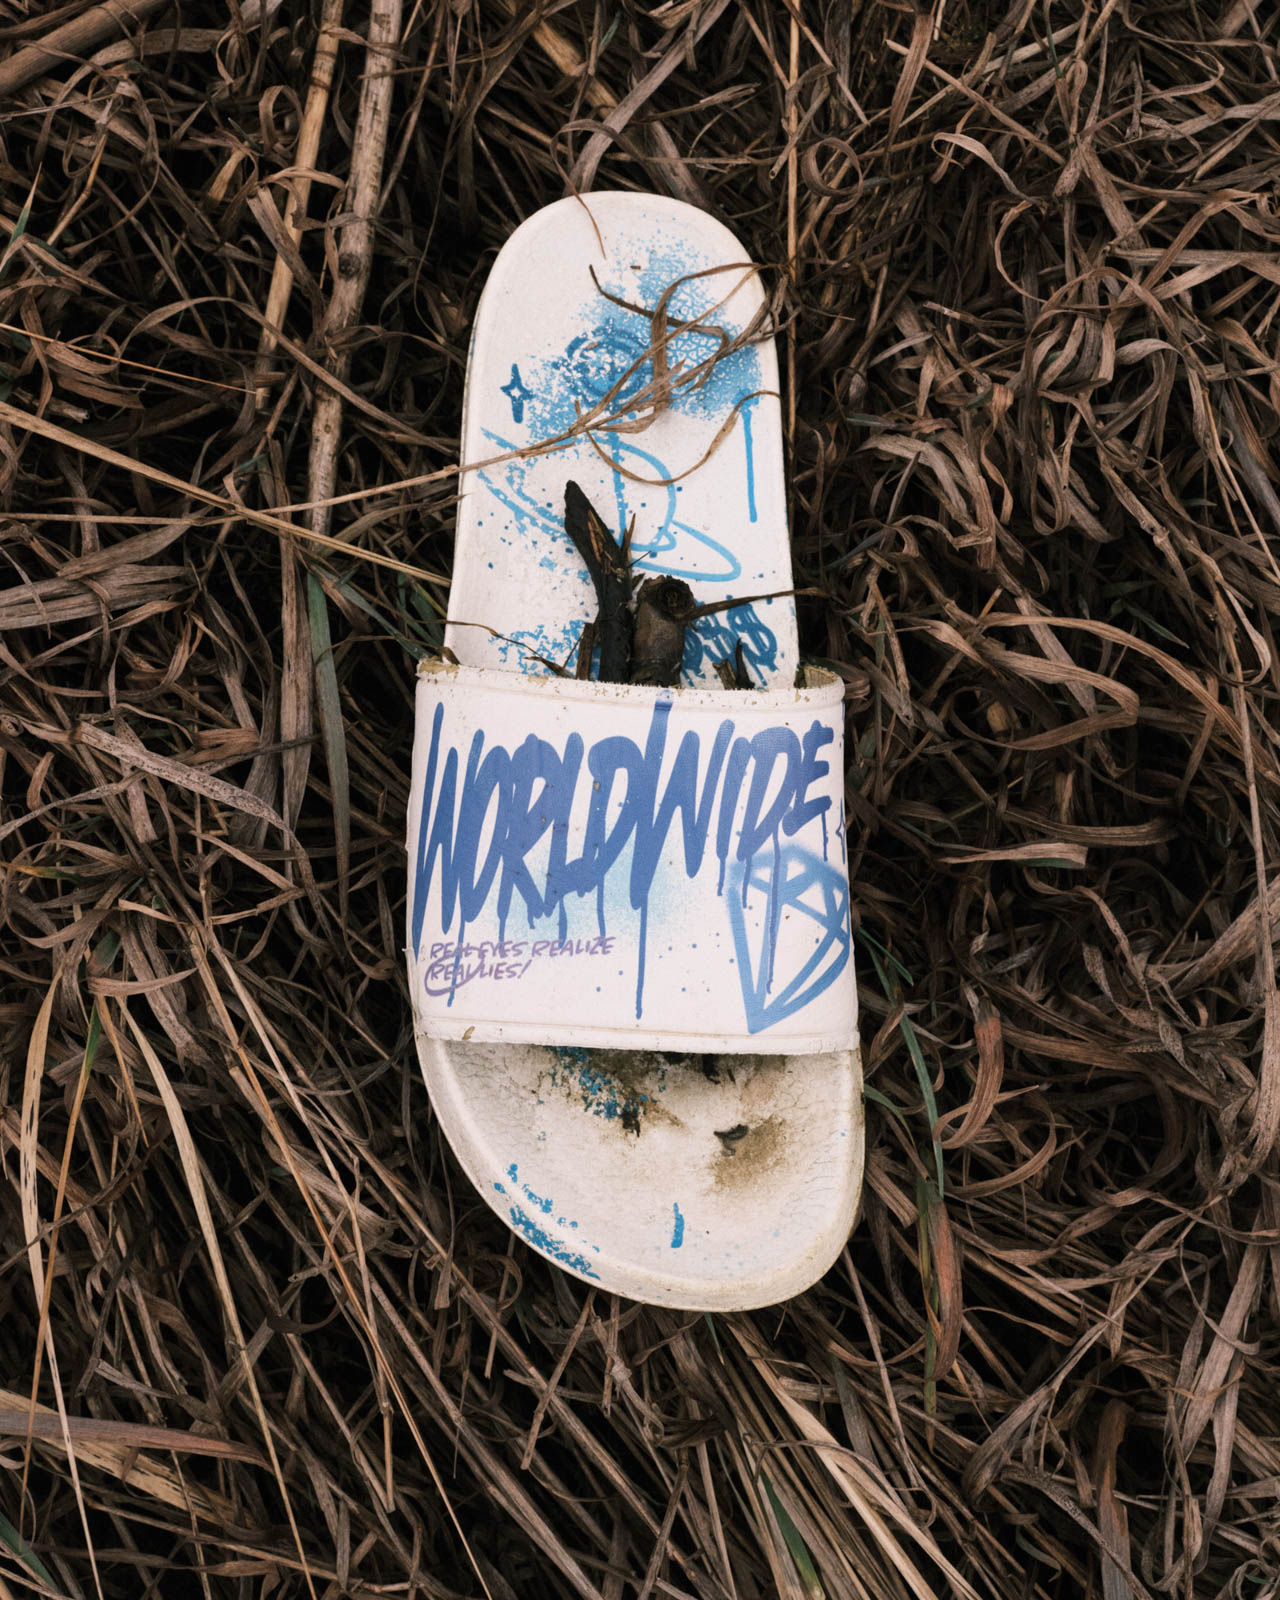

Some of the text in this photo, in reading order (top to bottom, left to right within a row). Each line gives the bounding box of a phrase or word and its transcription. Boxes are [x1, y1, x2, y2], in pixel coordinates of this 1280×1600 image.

[412, 689, 834, 963] WORLDWIDE
[478, 940, 528, 959] EYES
[531, 937, 616, 957] REALIZE
